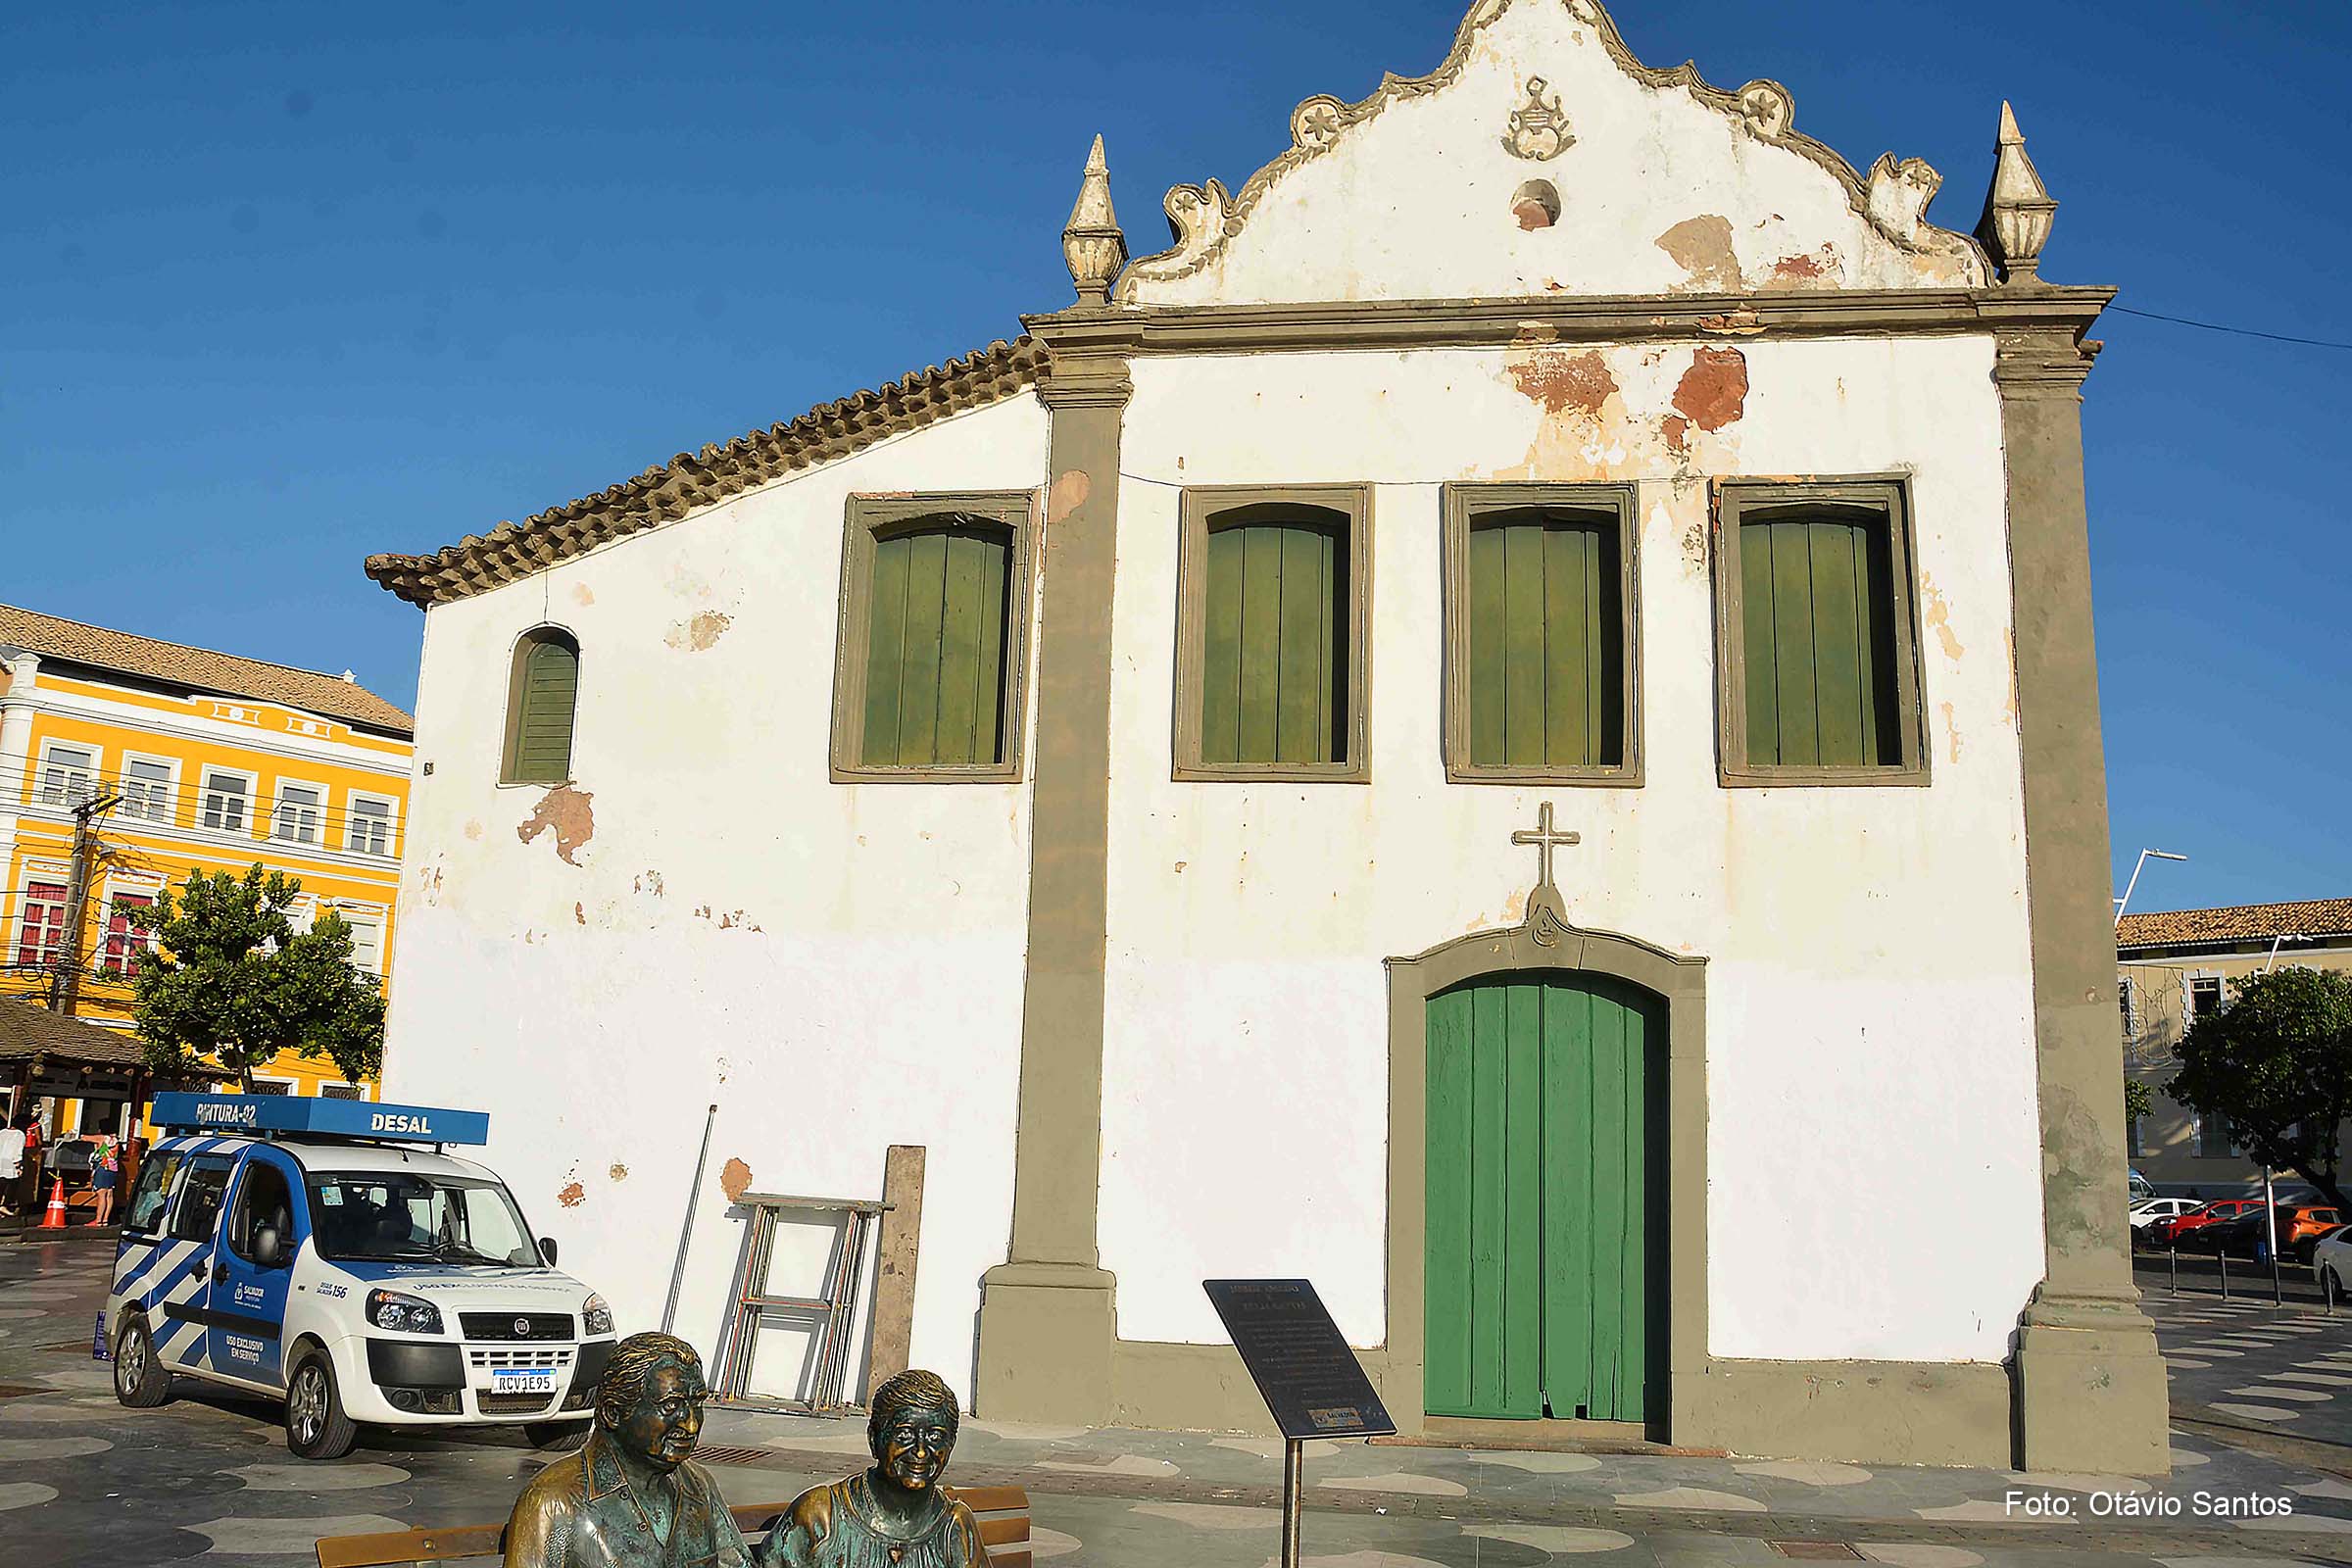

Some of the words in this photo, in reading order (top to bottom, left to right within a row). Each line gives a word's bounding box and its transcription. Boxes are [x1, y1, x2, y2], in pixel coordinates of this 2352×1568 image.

[371, 1113, 432, 1134] DESAL
[332, 1285, 348, 1298] 156
[226, 1335, 236, 1347] USO
[236, 1338, 264, 1351] EXCLUSIVO
[231, 1348, 240, 1358] EM
[239, 1349, 259, 1364] SERVIÇO
[499, 1377, 550, 1391] RCV1E95
